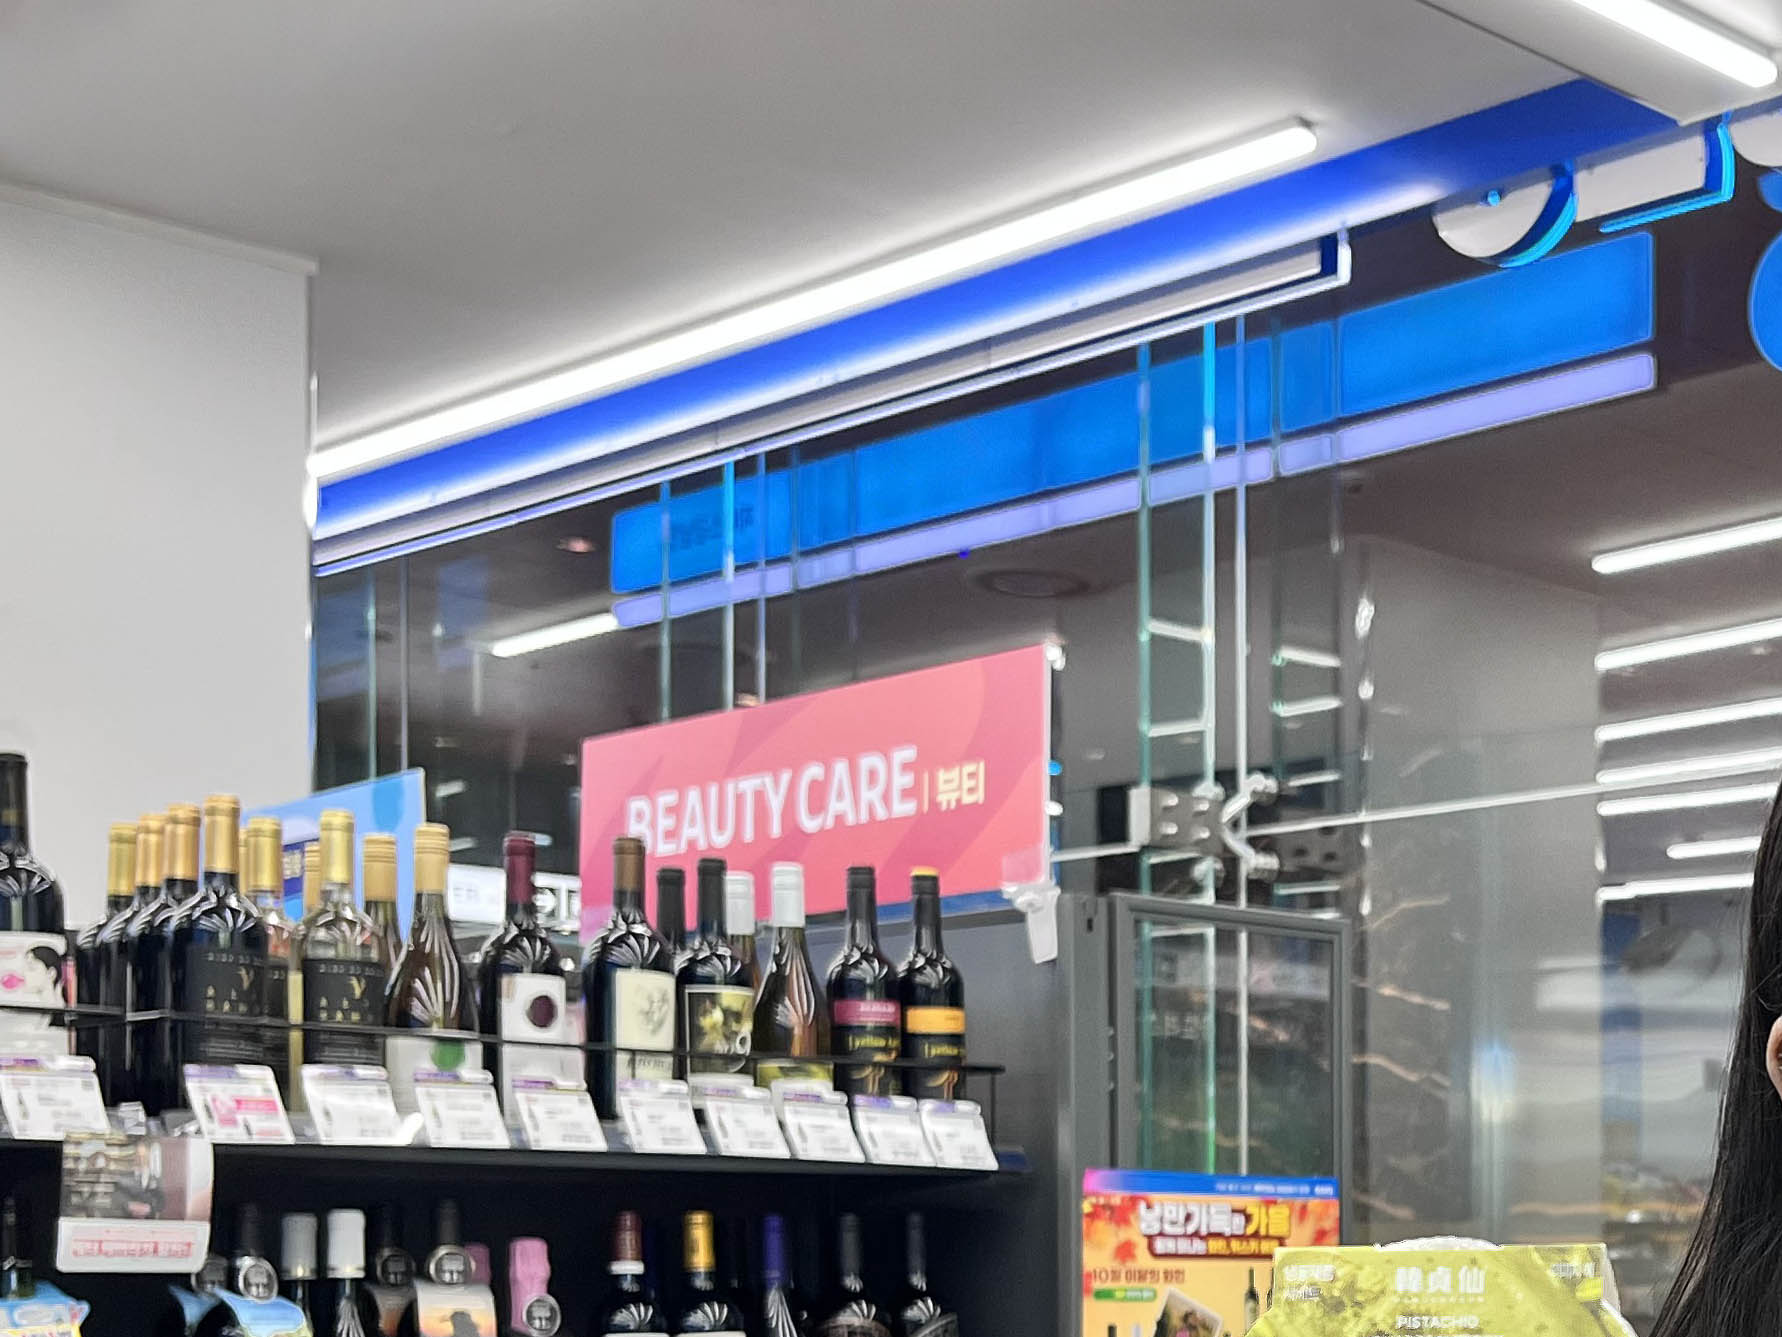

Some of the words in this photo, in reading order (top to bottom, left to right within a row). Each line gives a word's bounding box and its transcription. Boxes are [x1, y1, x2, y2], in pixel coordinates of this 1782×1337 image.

[626, 769, 793, 857] BEAUTY
[798, 745, 918, 834] CARE
[935, 760, 985, 812] 뷰티
[1395, 1314, 1480, 1330] PISTACHIO
